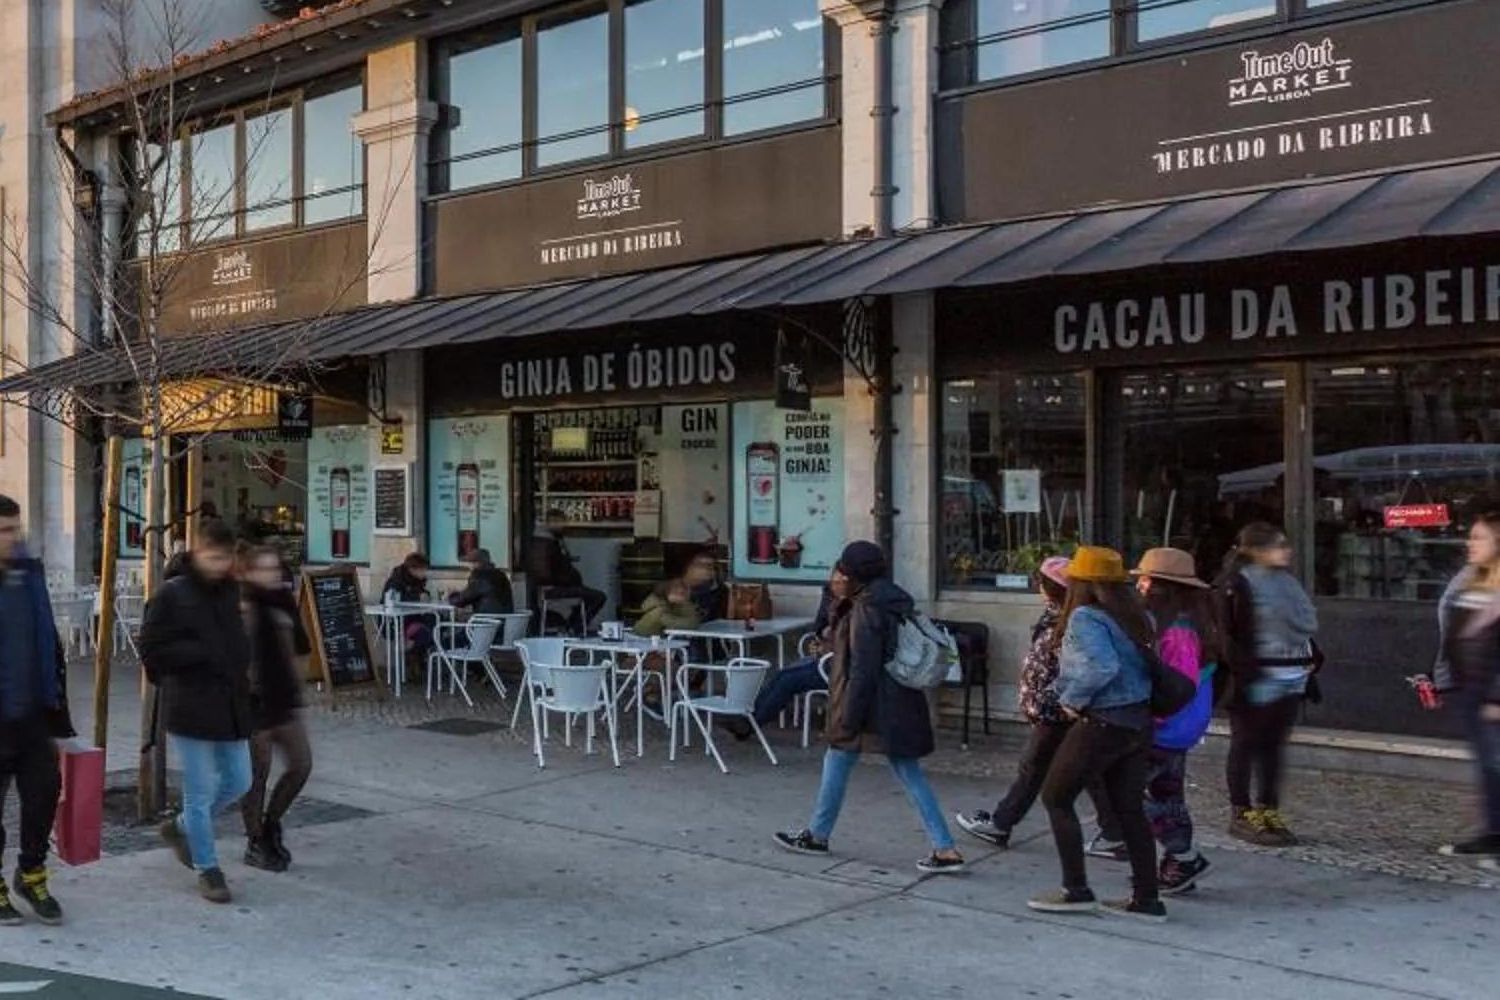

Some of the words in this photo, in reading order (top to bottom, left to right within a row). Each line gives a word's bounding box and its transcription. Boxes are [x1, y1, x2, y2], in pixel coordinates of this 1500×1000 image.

[1241, 50, 1293, 81] Time
[1292, 37, 1335, 72] Out
[1228, 65, 1352, 99] MARKET
[1266, 89, 1312, 103] LISBOA
[1153, 136, 1266, 174] MERCADO
[1278, 131, 1305, 156] DA
[1318, 111, 1434, 151] RIBEIRA
[577, 193, 642, 215] MARKET
[1054, 293, 1206, 354] CACAU
[1230, 285, 1298, 341] DA
[500, 356, 573, 399] GINJA
[582, 353, 617, 393] DE
[627, 342, 737, 390] ÓBIDOS
[681, 407, 719, 434] GIN
[785, 425, 831, 441] PODER
[785, 458, 832, 475] GINJA!
